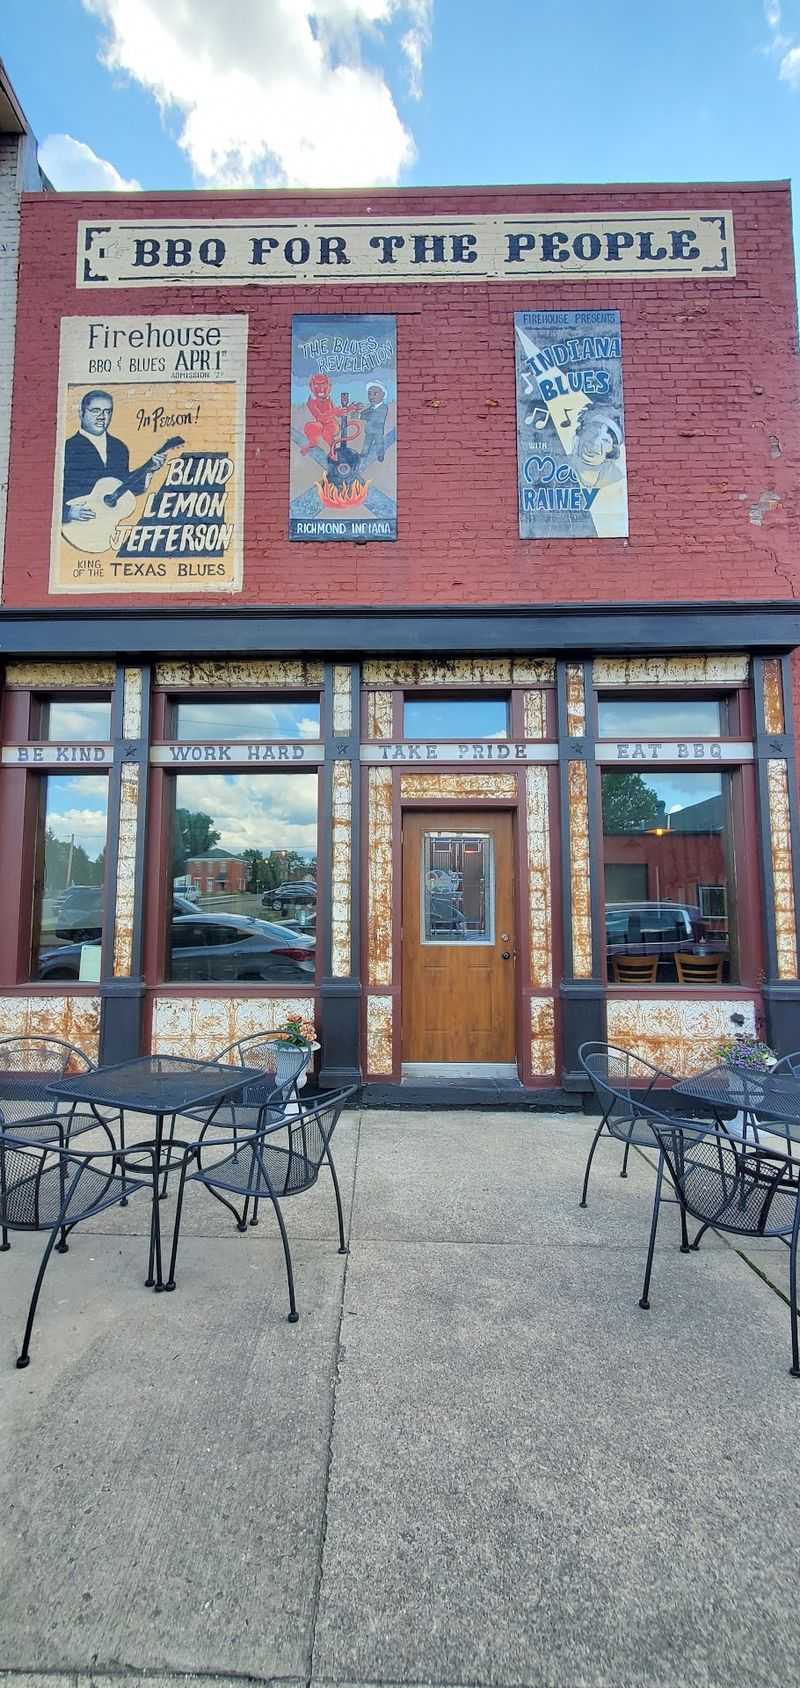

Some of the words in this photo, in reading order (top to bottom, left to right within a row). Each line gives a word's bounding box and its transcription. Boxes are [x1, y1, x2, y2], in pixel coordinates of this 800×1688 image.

[132, 238, 226, 268] BBQ
[249, 237, 350, 266] FOR
[369, 233, 478, 264] THE
[504, 229, 700, 263] PEOPLE
[523, 313, 569, 324] FIREHOUSE
[575, 313, 615, 323] PRESENTS
[88, 323, 222, 349] Firehouse
[299, 338, 329, 359] THE
[333, 336, 378, 355] BLUES
[316, 341, 394, 376] REVELATION
[525, 337, 621, 376] INDIANA
[88, 360, 112, 373] BBQ
[129, 358, 166, 372] BLUES
[170, 371, 211, 379] ADMISSION
[538, 370, 610, 401] BLUES
[136, 409, 150, 430] In
[528, 441, 547, 450] WITH
[164, 456, 235, 488] BLIND
[143, 491, 228, 519] LEMON
[522, 487, 600, 512] RAINEY
[296, 522, 347, 534] RICHMOND
[351, 522, 391, 534] INDIANA
[109, 523, 235, 552] JEFFERSON
[72, 569, 85, 578] OF
[87, 568, 104, 577] THE
[77, 560, 101, 569] KING
[110, 562, 167, 577] TEXAS
[177, 563, 226, 577] BLUES
[17, 748, 44, 762] BE
[56, 747, 106, 762] KIND
[169, 746, 232, 761] WORK
[247, 746, 305, 760] HARD
[378, 744, 438, 760] TAKE
[457, 744, 528, 759] PRIDE
[617, 744, 662, 760] EAT
[678, 743, 723, 759] BBQ
